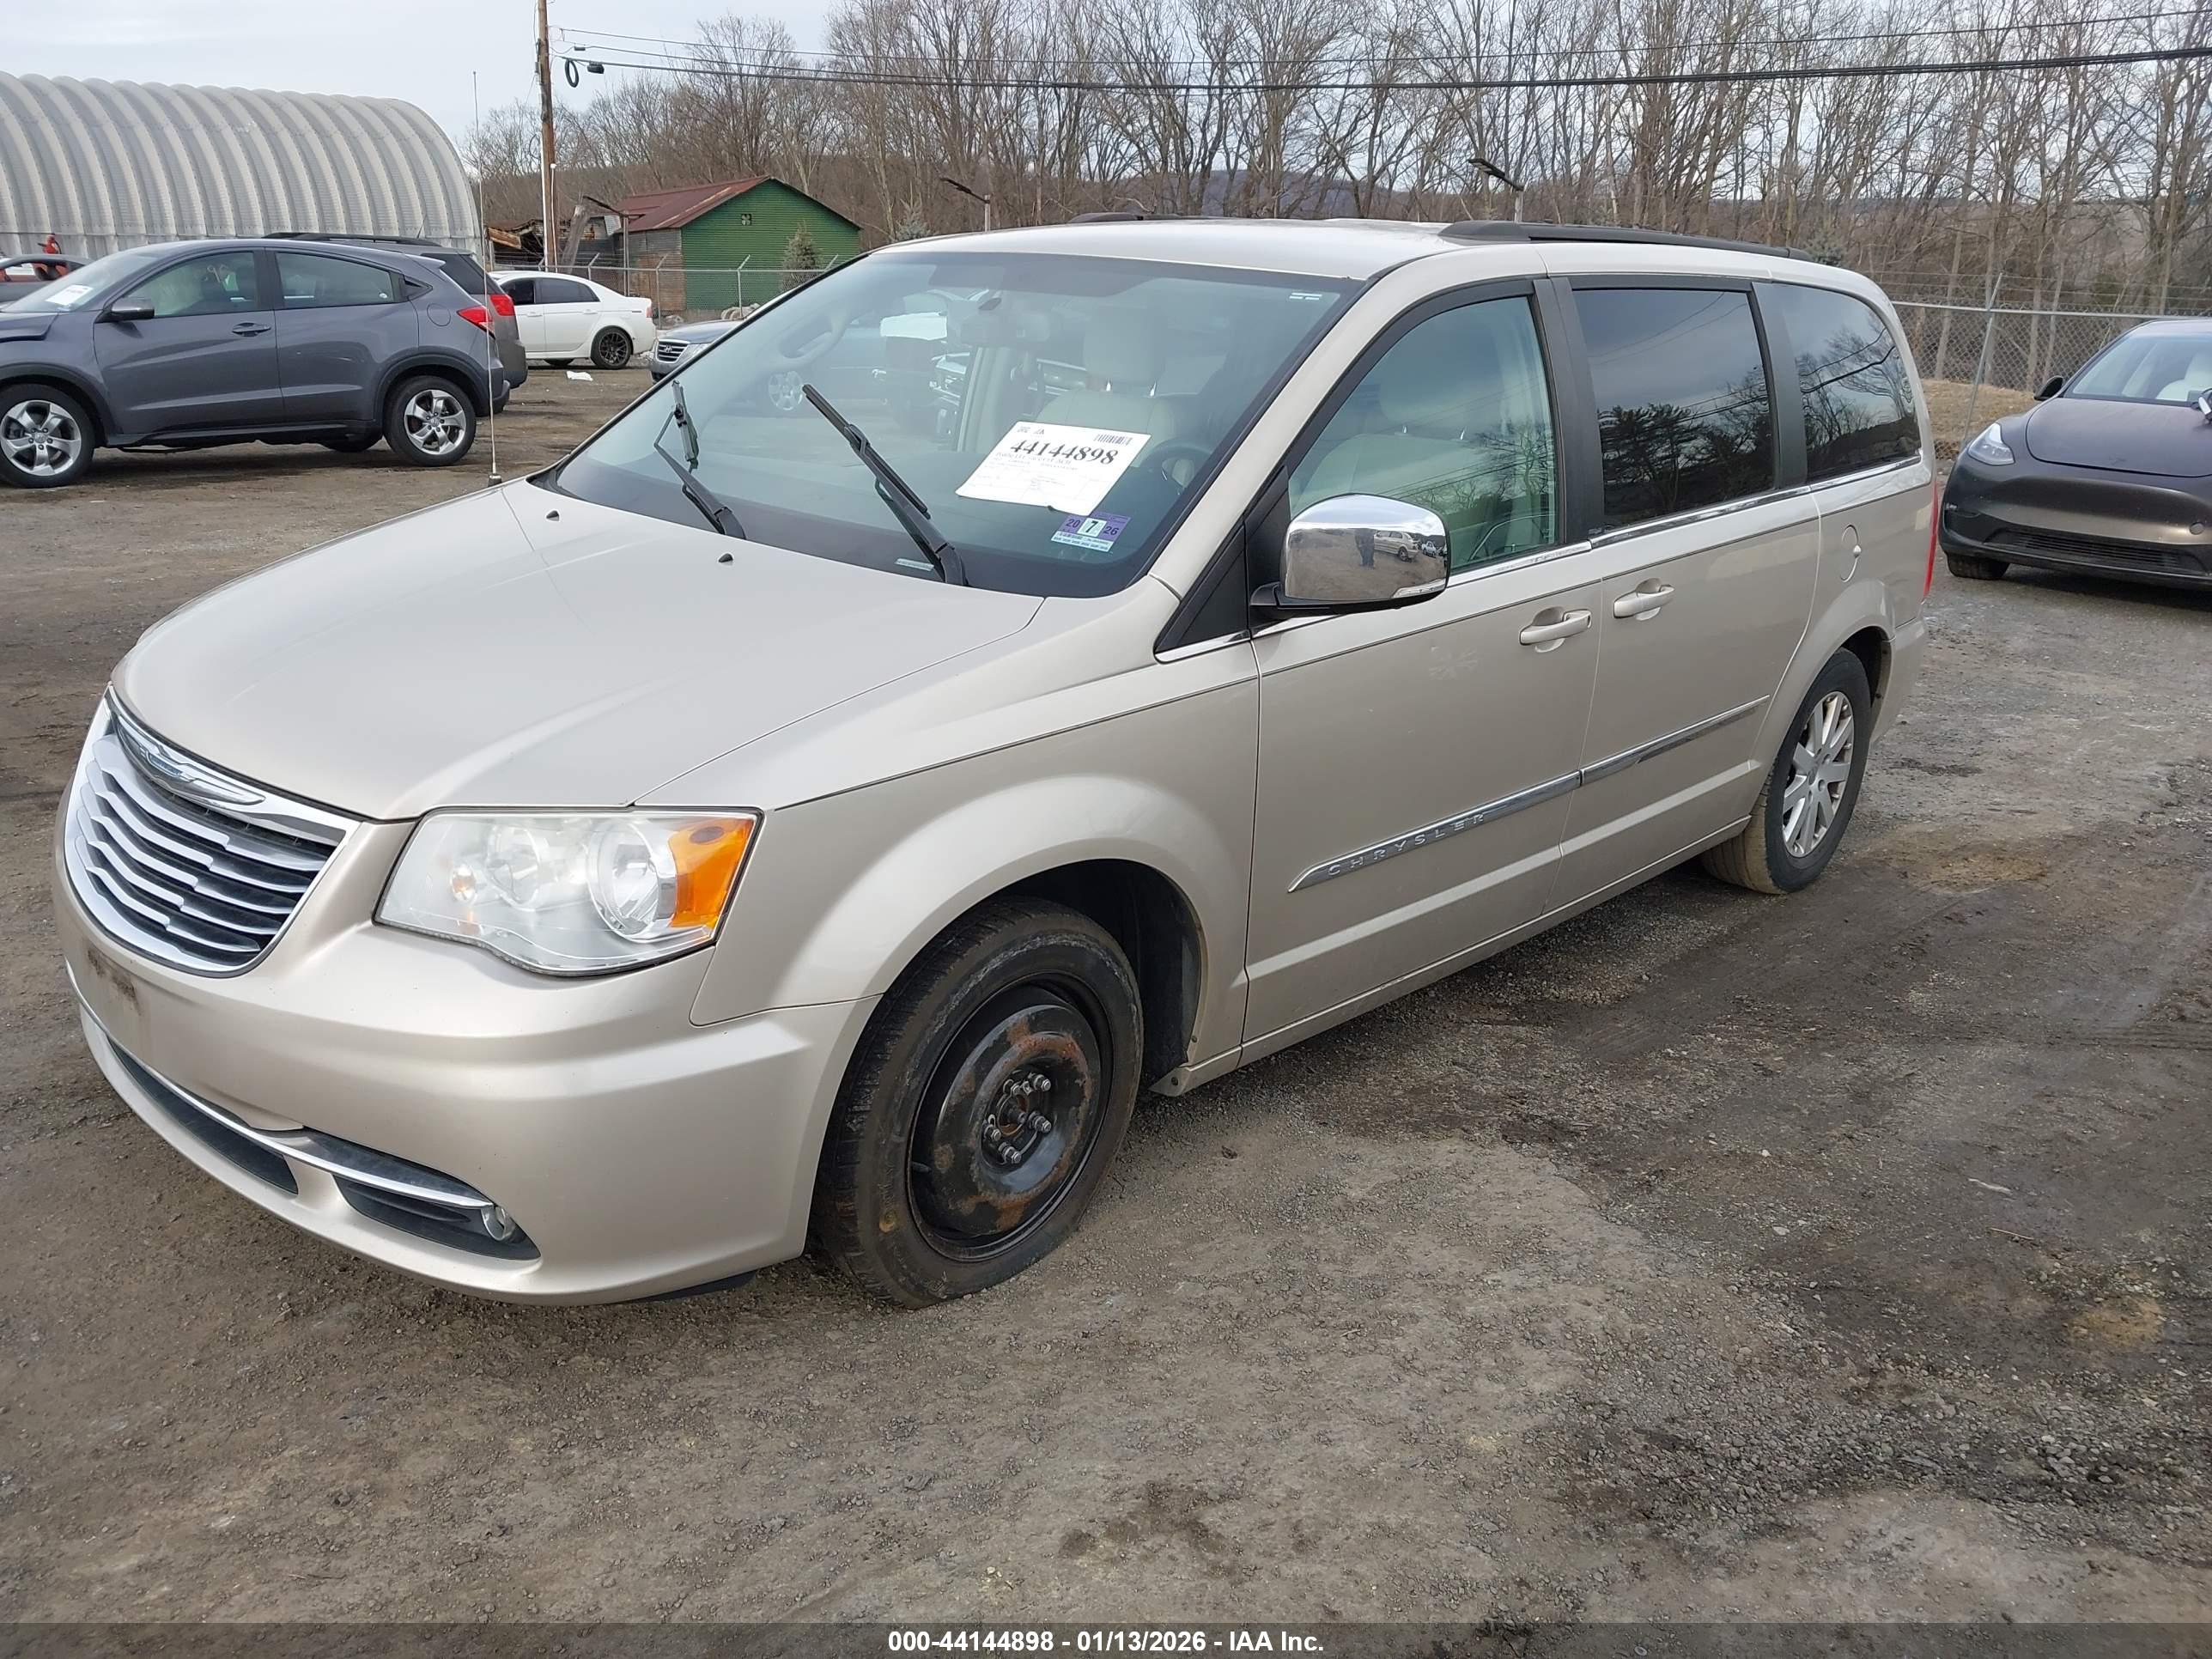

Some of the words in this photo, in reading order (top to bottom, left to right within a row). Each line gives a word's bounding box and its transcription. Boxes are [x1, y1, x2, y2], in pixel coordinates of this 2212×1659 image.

[1010, 439, 1119, 465] 44144898
[1066, 518, 1081, 528] 20
[1085, 520, 1098, 533] 7
[1103, 526, 1119, 536] 26
[1328, 813, 1485, 877] CHRYSLER
